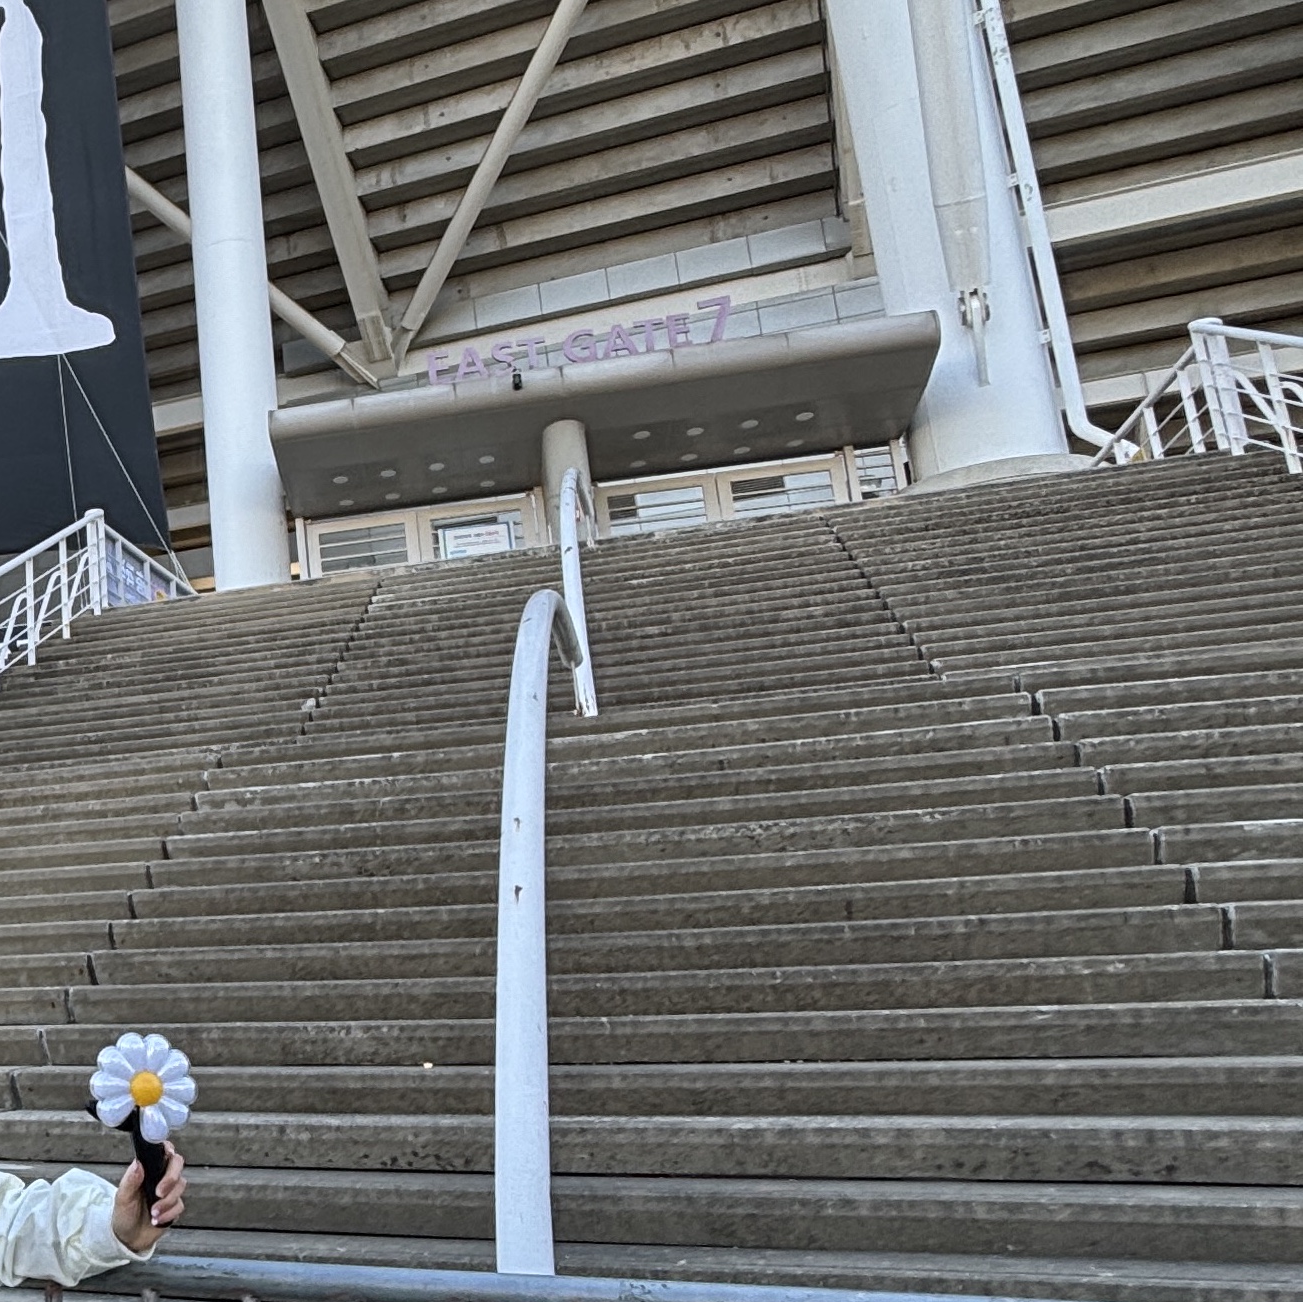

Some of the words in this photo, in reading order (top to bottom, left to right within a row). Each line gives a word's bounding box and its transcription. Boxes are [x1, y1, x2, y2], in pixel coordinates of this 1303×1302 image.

[426, 336, 546, 386] EAST
[563, 312, 693, 363] GATE
[697, 295, 731, 343] 7
